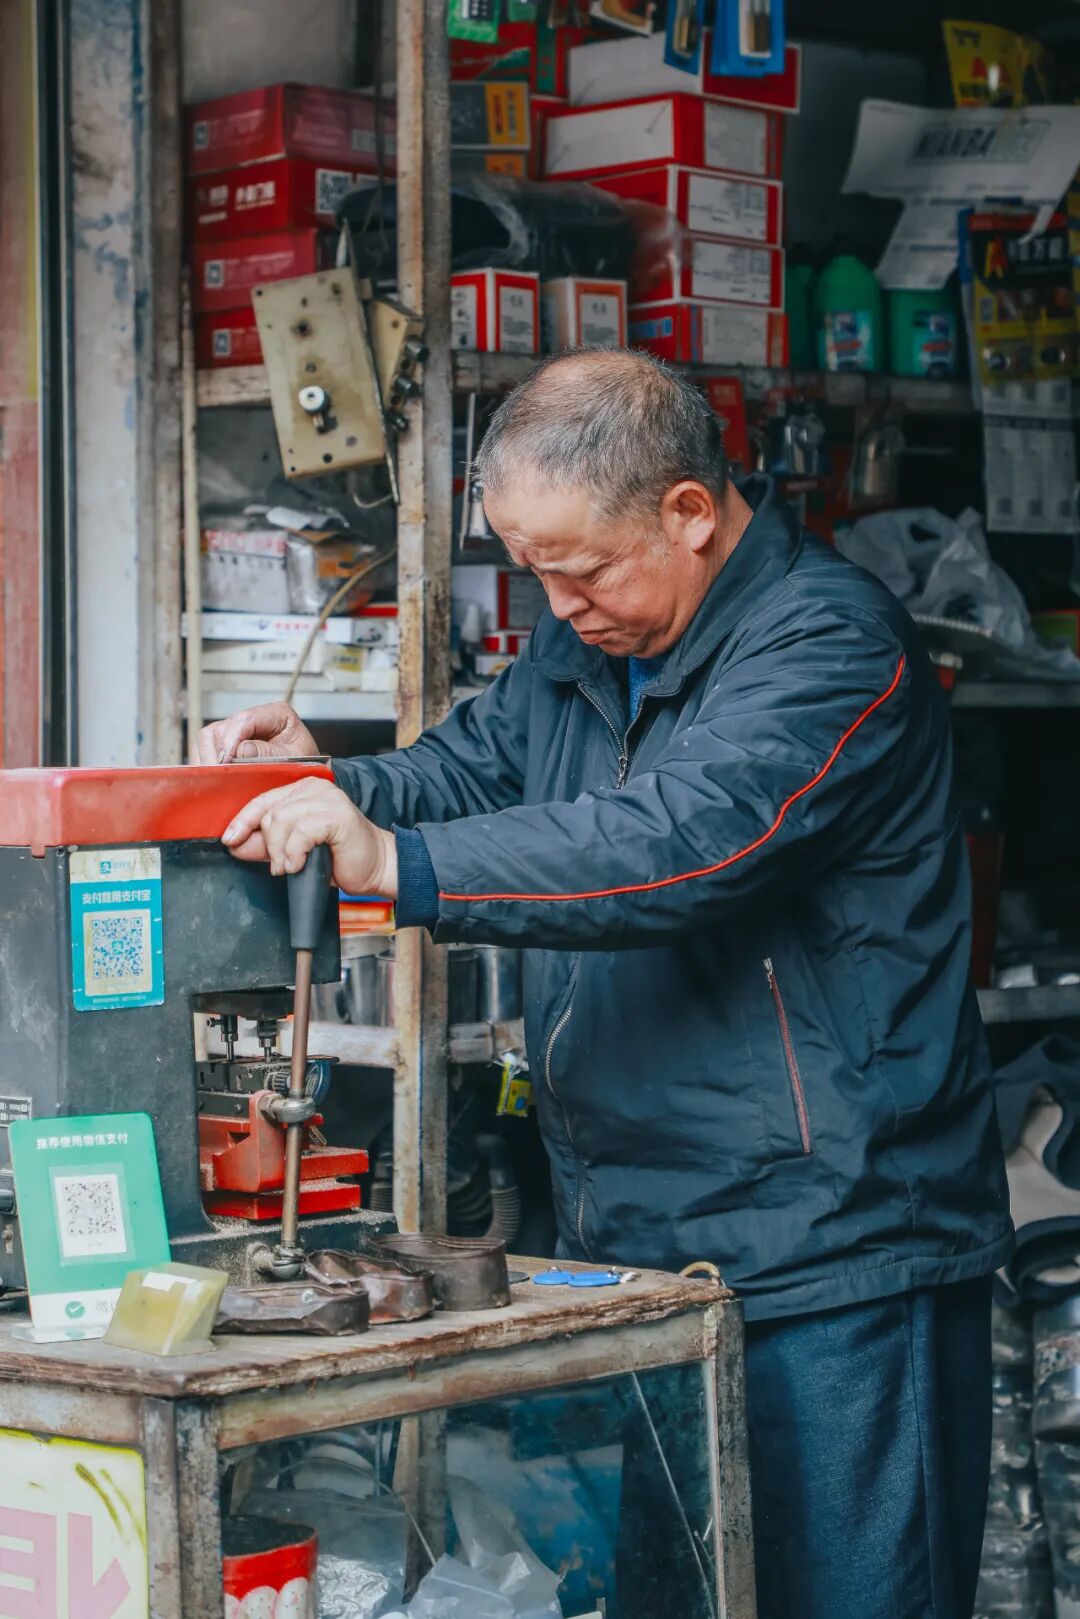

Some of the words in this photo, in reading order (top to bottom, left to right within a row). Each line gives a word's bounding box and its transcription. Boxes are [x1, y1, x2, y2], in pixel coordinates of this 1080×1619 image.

[36, 1133, 128, 1150] 推荐使用微信支付
